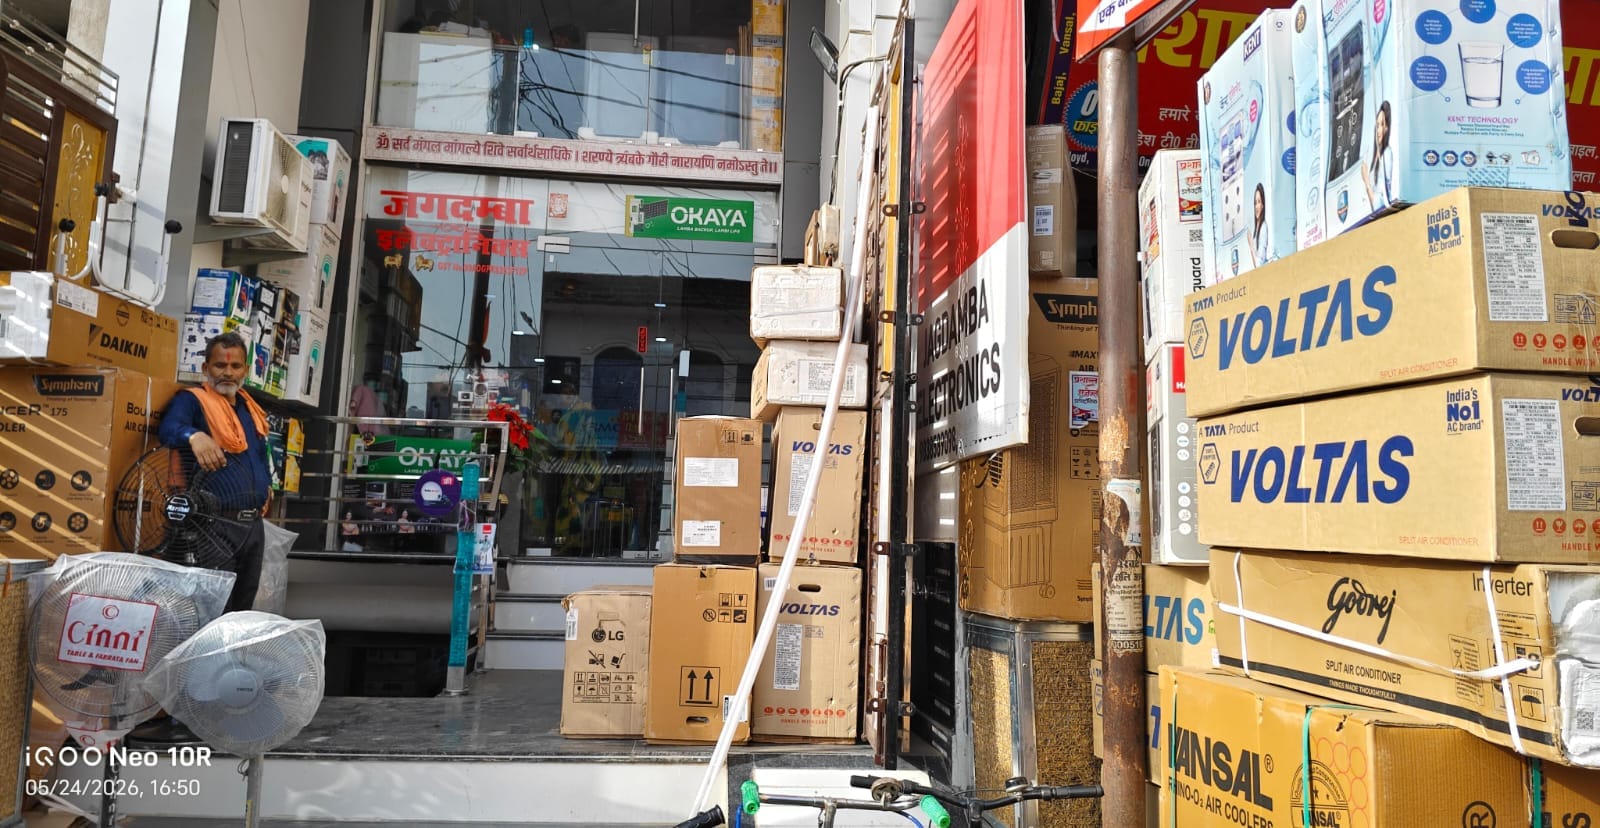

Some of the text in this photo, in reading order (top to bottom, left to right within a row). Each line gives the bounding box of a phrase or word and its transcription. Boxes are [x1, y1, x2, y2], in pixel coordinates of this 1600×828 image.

[1244, 28, 1261, 60] KENT
[1051, 12, 1077, 105] Bajaj, Vansal,
[1081, 90, 1098, 116] 0
[1159, 105, 1190, 121] हमारे
[1468, 116, 1519, 124] TECHNOLOGY
[1073, 120, 1098, 134] फाइ
[1069, 151, 1090, 165] loyd,
[1138, 156, 1152, 168] On
[380, 190, 535, 226] जगदम्बा
[1427, 205, 1458, 226] India's
[670, 206, 747, 228] OKAYA
[1428, 244, 1439, 255] AC
[1193, 296, 1214, 313] TATA
[1216, 286, 1247, 305] Product
[1047, 299, 1097, 319] Symph
[1219, 265, 1397, 371] VOLTAS
[100, 332, 148, 359] DAIKIN
[1380, 368, 1399, 379] SPLIT
[1410, 357, 1458, 373] CONDITIONER
[1542, 357, 1572, 367] HANDLE
[40, 378, 99, 393] Symphony
[1446, 387, 1478, 403] India's
[1562, 387, 1600, 402] VOLT
[51, 407, 68, 417] 175
[125, 422, 137, 432] AIR
[1204, 424, 1226, 437] TATA
[1229, 421, 1260, 435] Product
[1447, 422, 1458, 432] AC
[792, 441, 852, 456] VOAS
[1231, 435, 1414, 504] VOLTAS
[1399, 536, 1479, 547] SPLIT AIR CONDITIONER
[1561, 543, 1592, 551] HANDLE
[1322, 577, 1396, 645] Godrej
[67, 620, 144, 652] Cinni
[608, 631, 624, 641] LG
[1326, 659, 1402, 685] SPLIT AIR CONDITIONER
[1205, 794, 1222, 817] AIR
